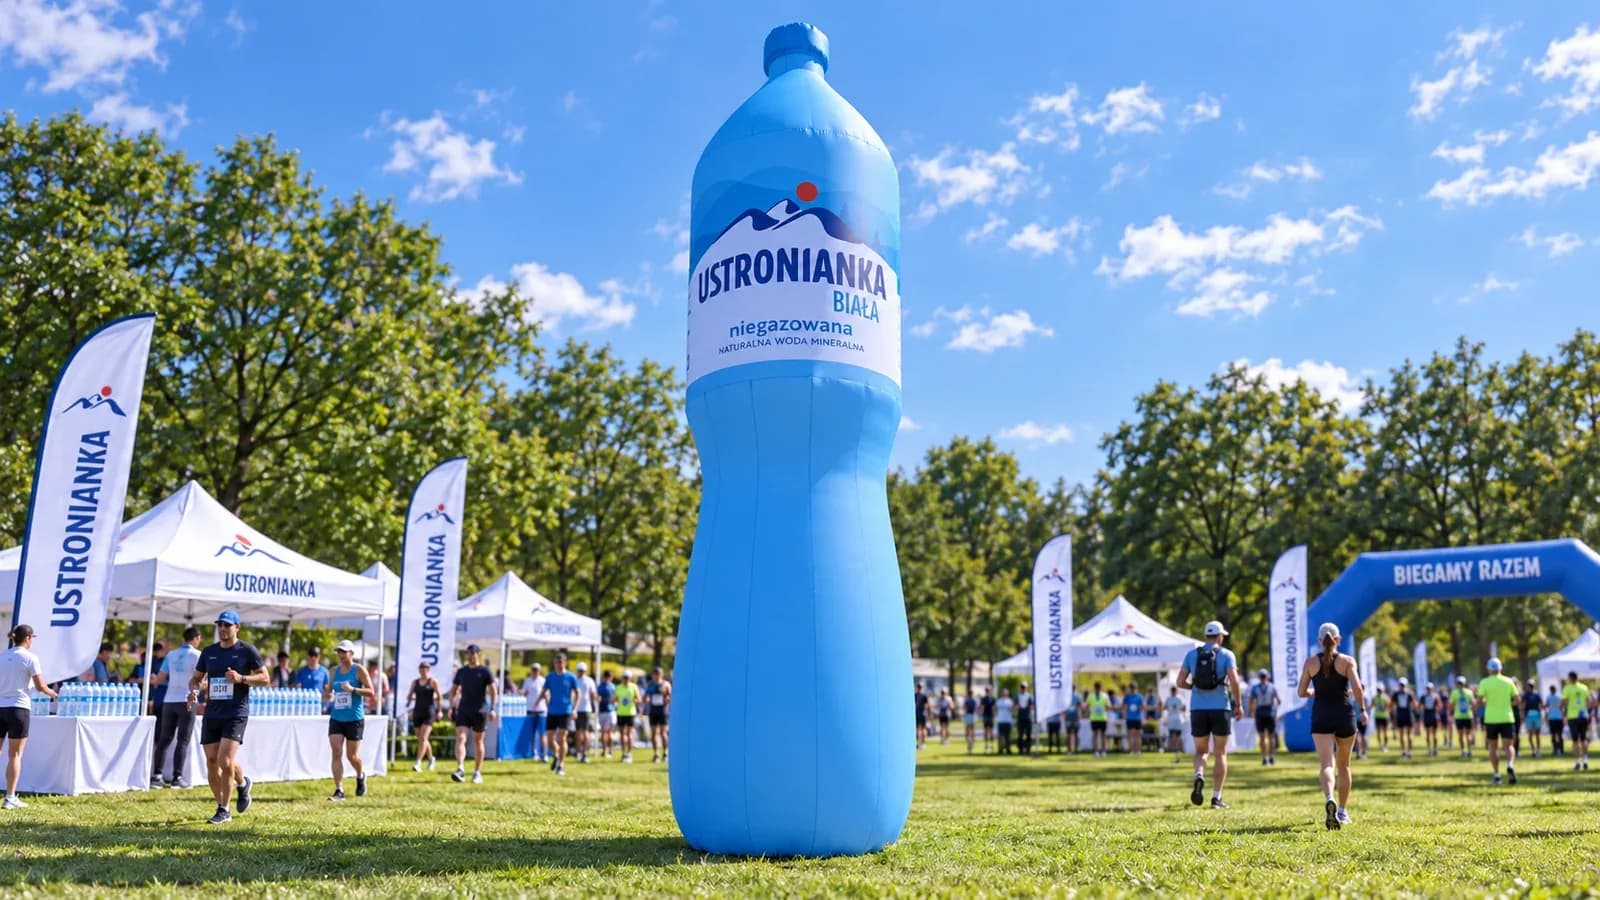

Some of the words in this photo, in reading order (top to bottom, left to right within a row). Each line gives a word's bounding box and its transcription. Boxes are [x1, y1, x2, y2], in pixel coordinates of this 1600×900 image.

[698, 247, 887, 303] USTRONIANKA
[833, 290, 880, 323] BIAŁA
[718, 337, 772, 354] NATURALNA
[775, 336, 808, 345] WODA
[811, 338, 865, 352] MINERALNA
[729, 319, 853, 338] niegazowana
[50, 430, 111, 627] USTRONIANKA
[225, 572, 316, 599] USTRONIANKA
[1393, 561, 1473, 586] BIEGAMY
[1478, 556, 1541, 581] RAZEM
[421, 534, 446, 666] USTRONIANKA
[1049, 590, 1063, 690] USTRONIANKA
[1094, 646, 1158, 658] USTRONIANKA
[1285, 597, 1298, 688] USTRONIANKA
